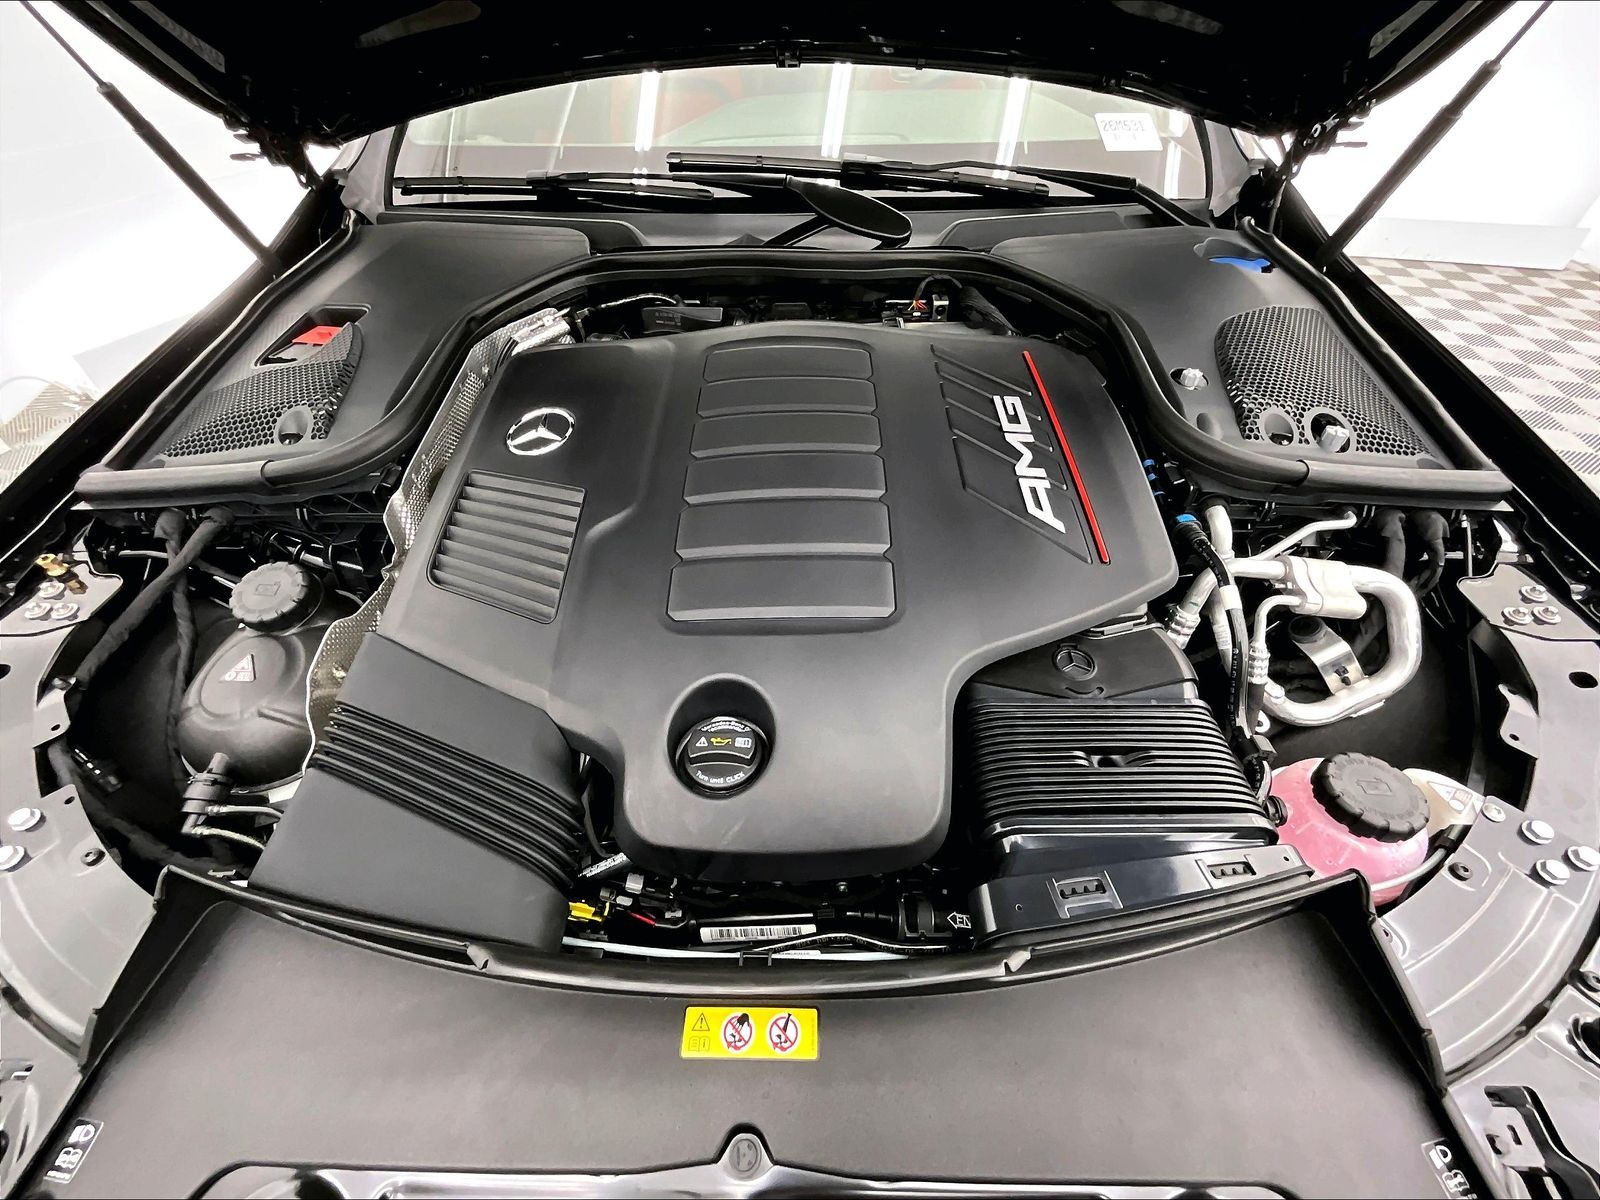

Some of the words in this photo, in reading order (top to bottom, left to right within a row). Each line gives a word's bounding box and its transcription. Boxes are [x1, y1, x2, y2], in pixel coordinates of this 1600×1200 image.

[993, 395, 1066, 534] AMG
[695, 770, 709, 782] Turn
[726, 771, 745, 783] CLICK
